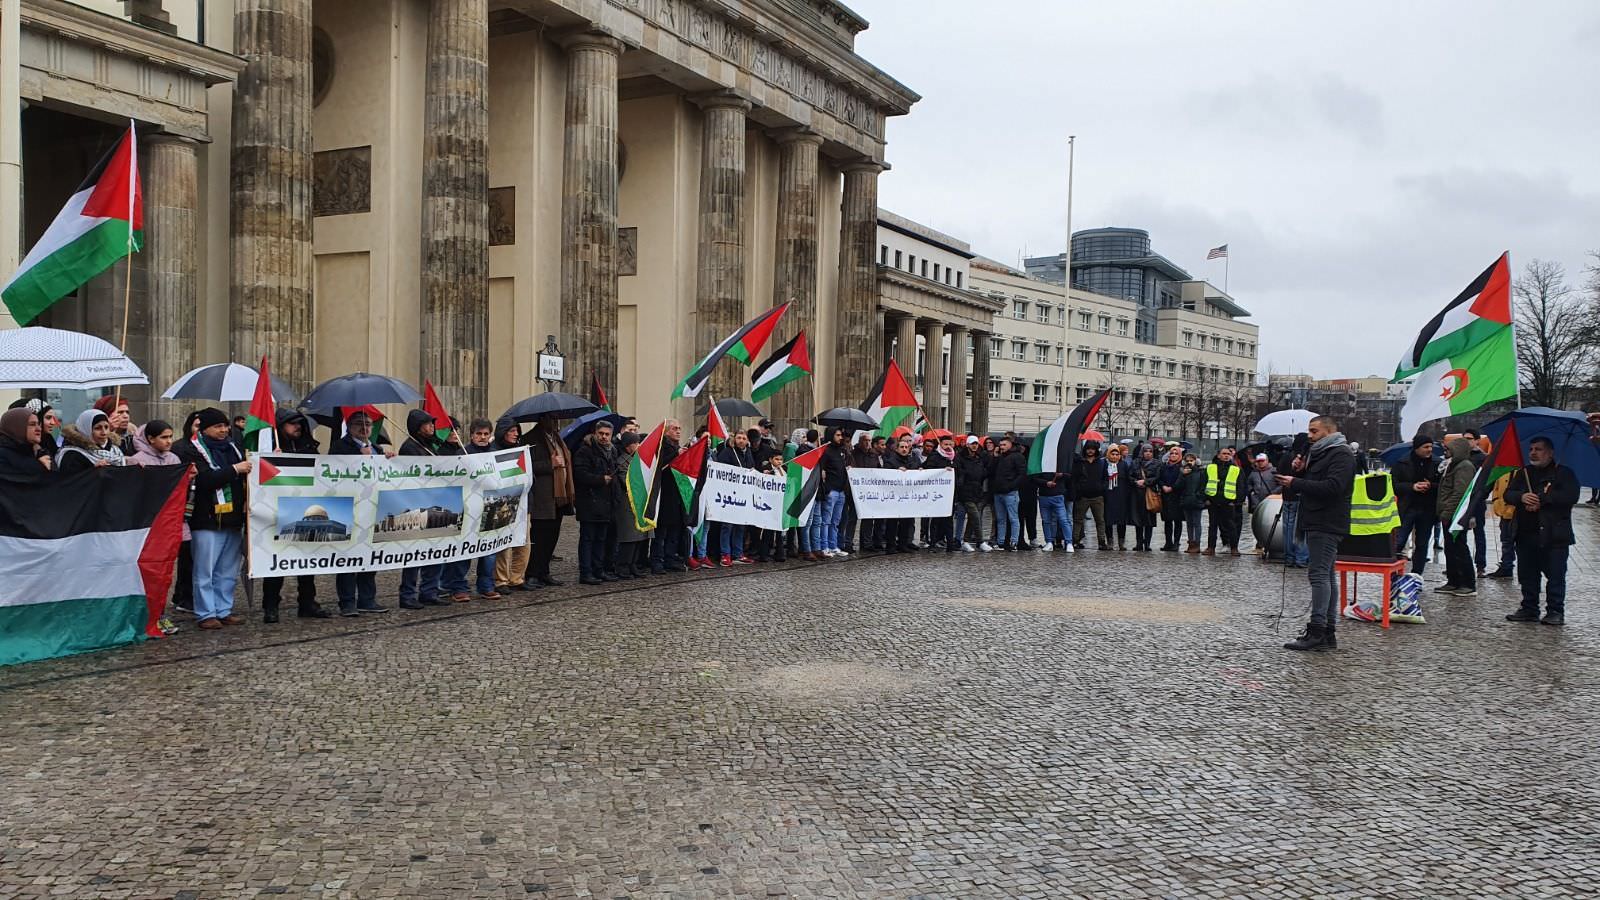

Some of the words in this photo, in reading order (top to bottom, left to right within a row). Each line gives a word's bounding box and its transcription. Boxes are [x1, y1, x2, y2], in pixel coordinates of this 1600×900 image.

[321, 462, 376, 482] الأبدية
[378, 463, 422, 482] فلسطين
[423, 463, 467, 478] عاصمة
[469, 462, 496, 480] القدس
[715, 468, 741, 485] werden
[741, 474, 786, 493] zurkehre
[931, 491, 944, 502] حق
[270, 552, 364, 571] Jerusalem
[370, 544, 457, 566] Hauptstadt
[460, 533, 513, 556] Palästinas
